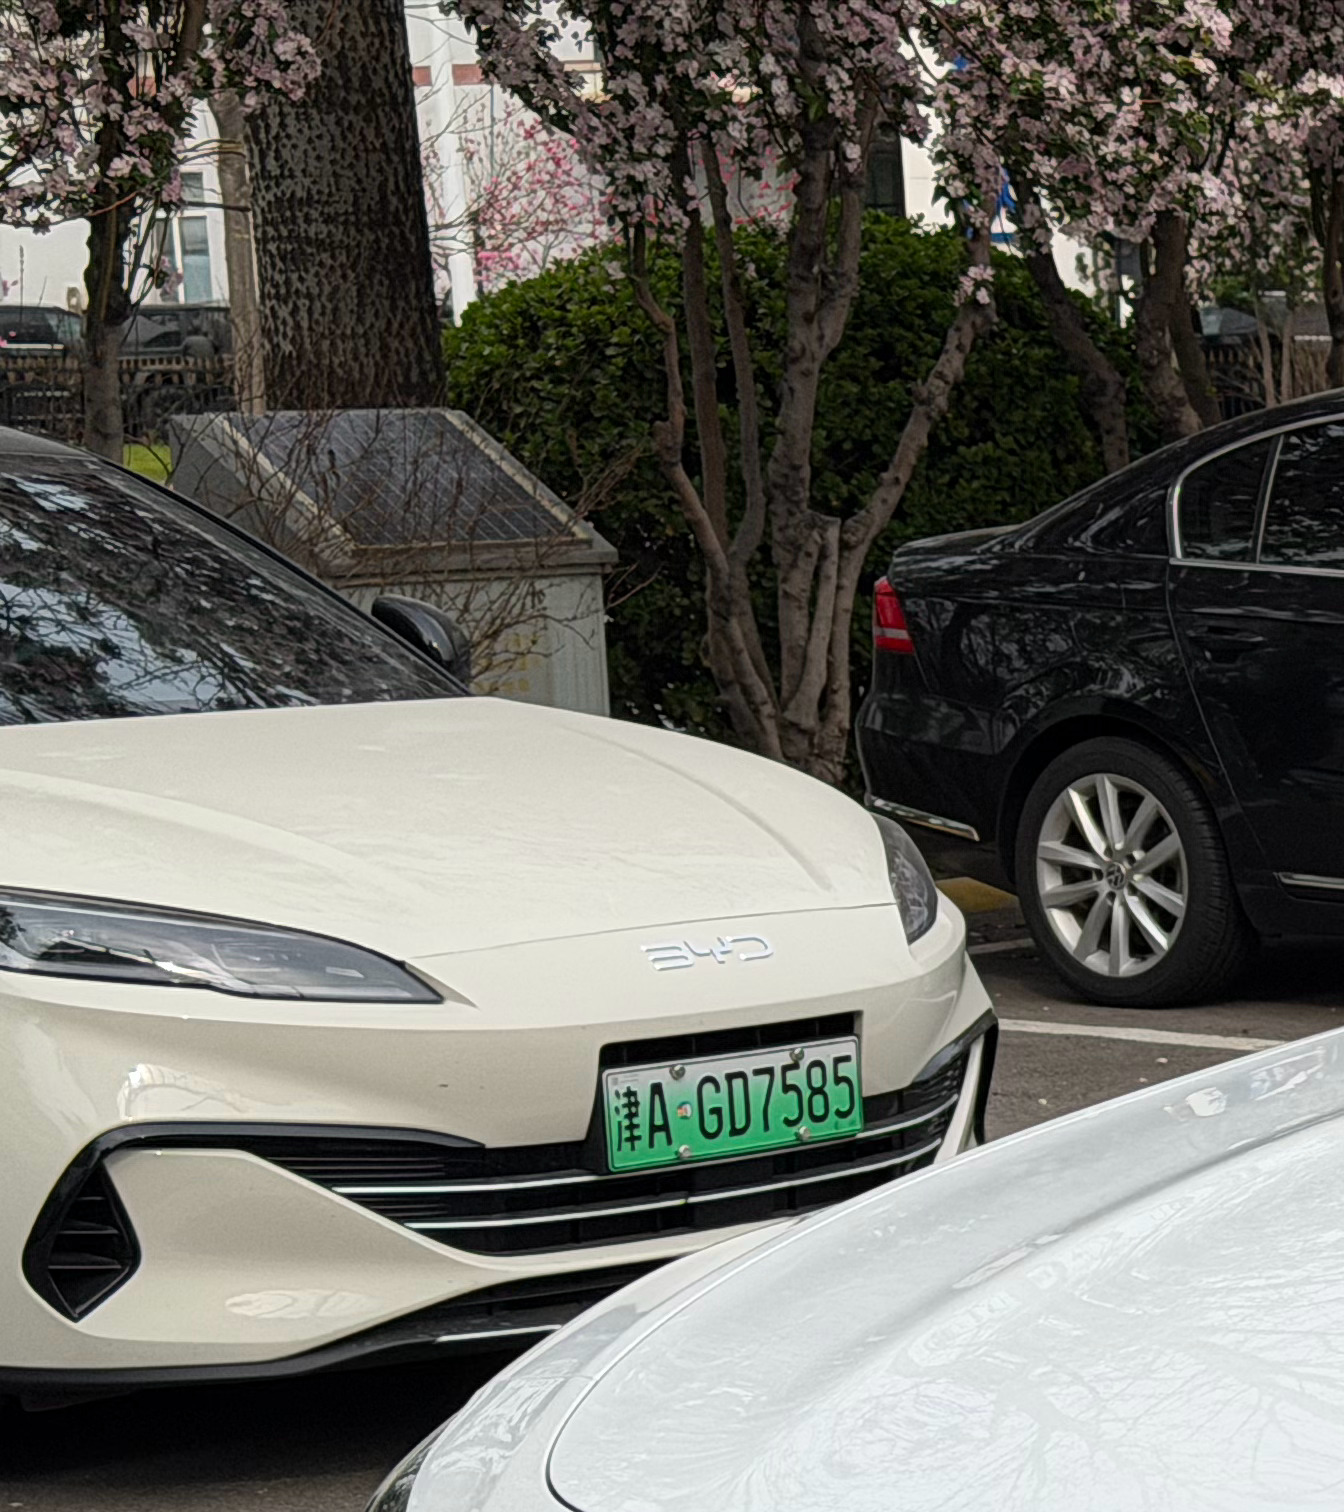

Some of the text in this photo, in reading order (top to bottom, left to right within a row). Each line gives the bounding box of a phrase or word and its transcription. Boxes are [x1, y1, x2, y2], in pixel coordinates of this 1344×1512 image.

[640, 935, 774, 971] BYD
[615, 1054, 856, 1152] 津A GD7585
